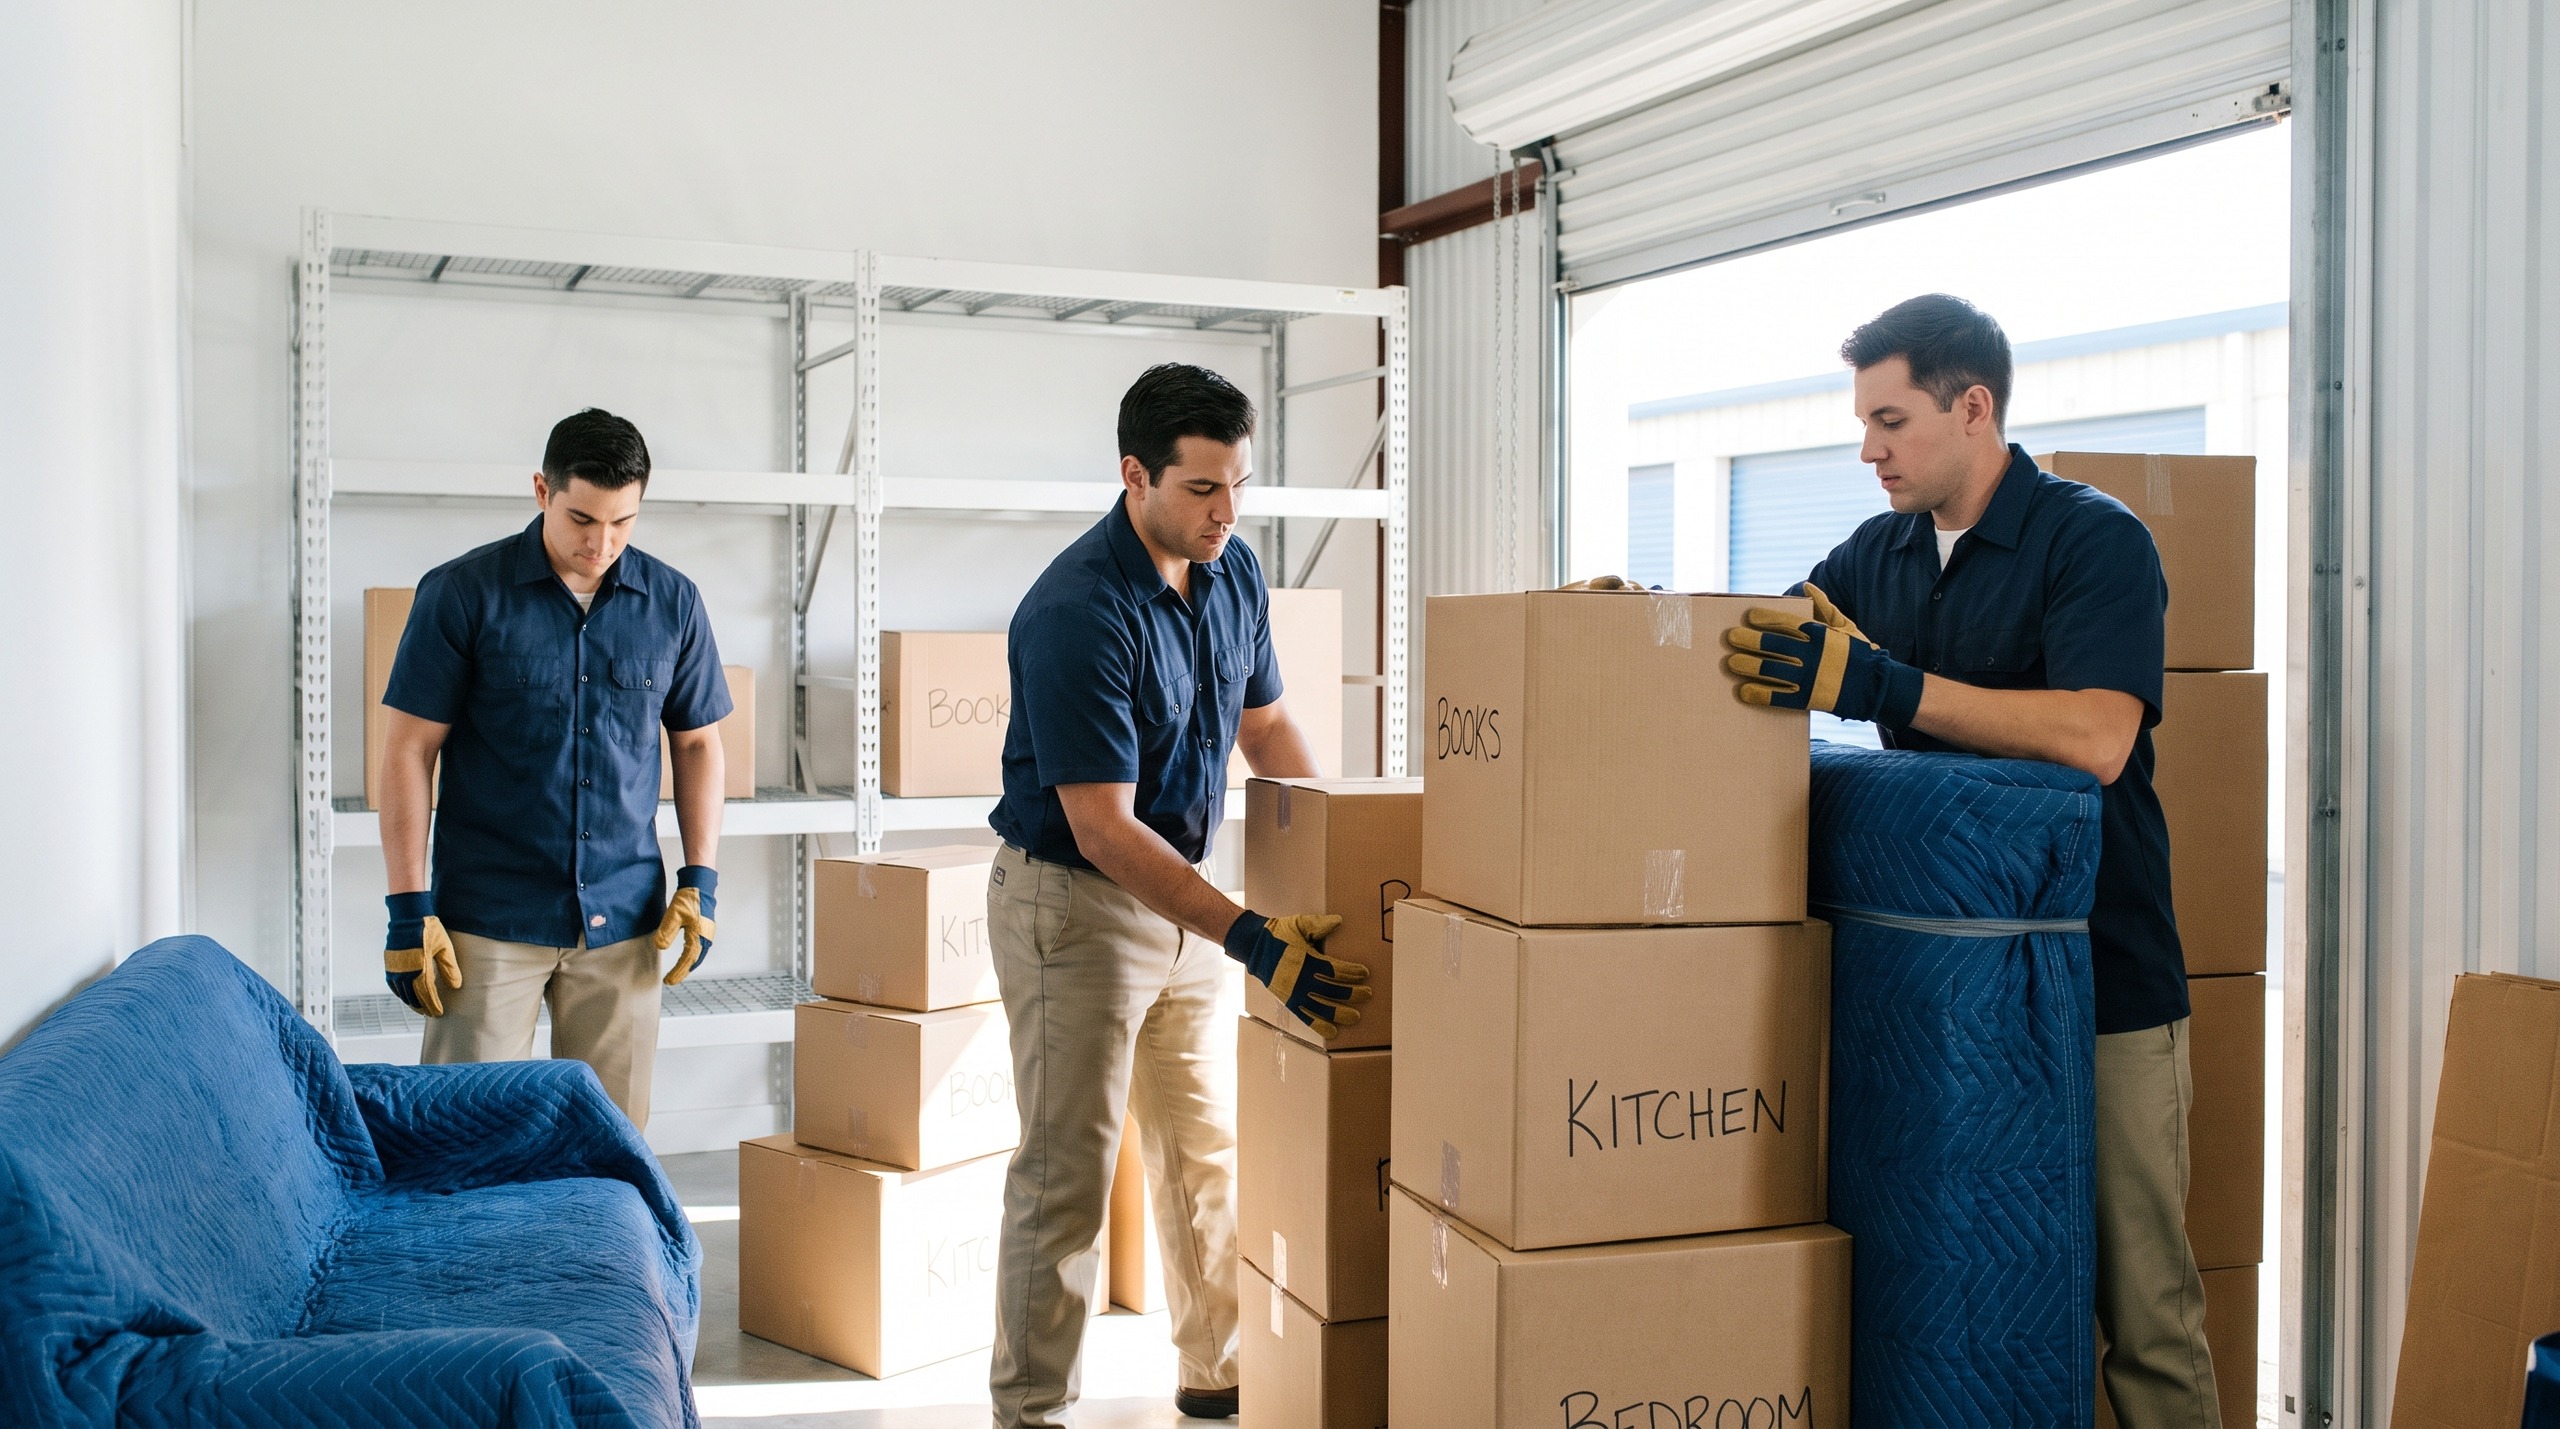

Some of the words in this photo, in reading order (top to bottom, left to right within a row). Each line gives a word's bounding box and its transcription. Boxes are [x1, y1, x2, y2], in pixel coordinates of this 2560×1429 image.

[1437, 696, 1502, 763] BOOKS
[941, 915, 989, 963] KIT
[1568, 1078, 1786, 1157] KITCHEN
